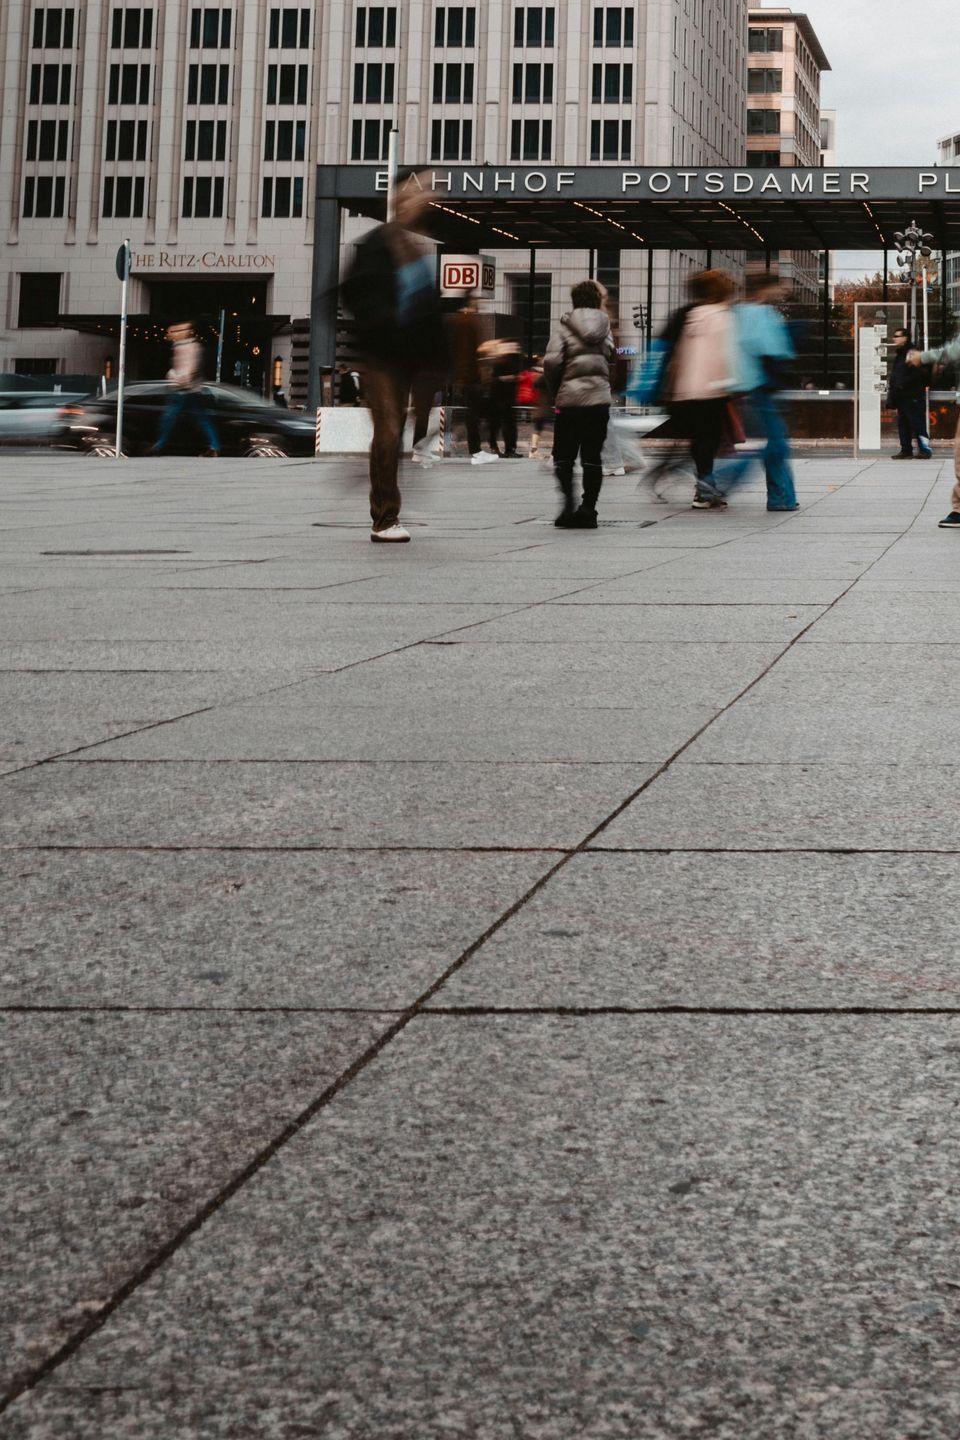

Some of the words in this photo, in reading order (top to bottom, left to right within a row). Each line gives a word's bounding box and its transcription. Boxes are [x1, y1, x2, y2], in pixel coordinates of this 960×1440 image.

[621, 171, 872, 194] POTSDAMER
[447, 267, 475, 285] DB
[483, 265, 494, 286] DB
